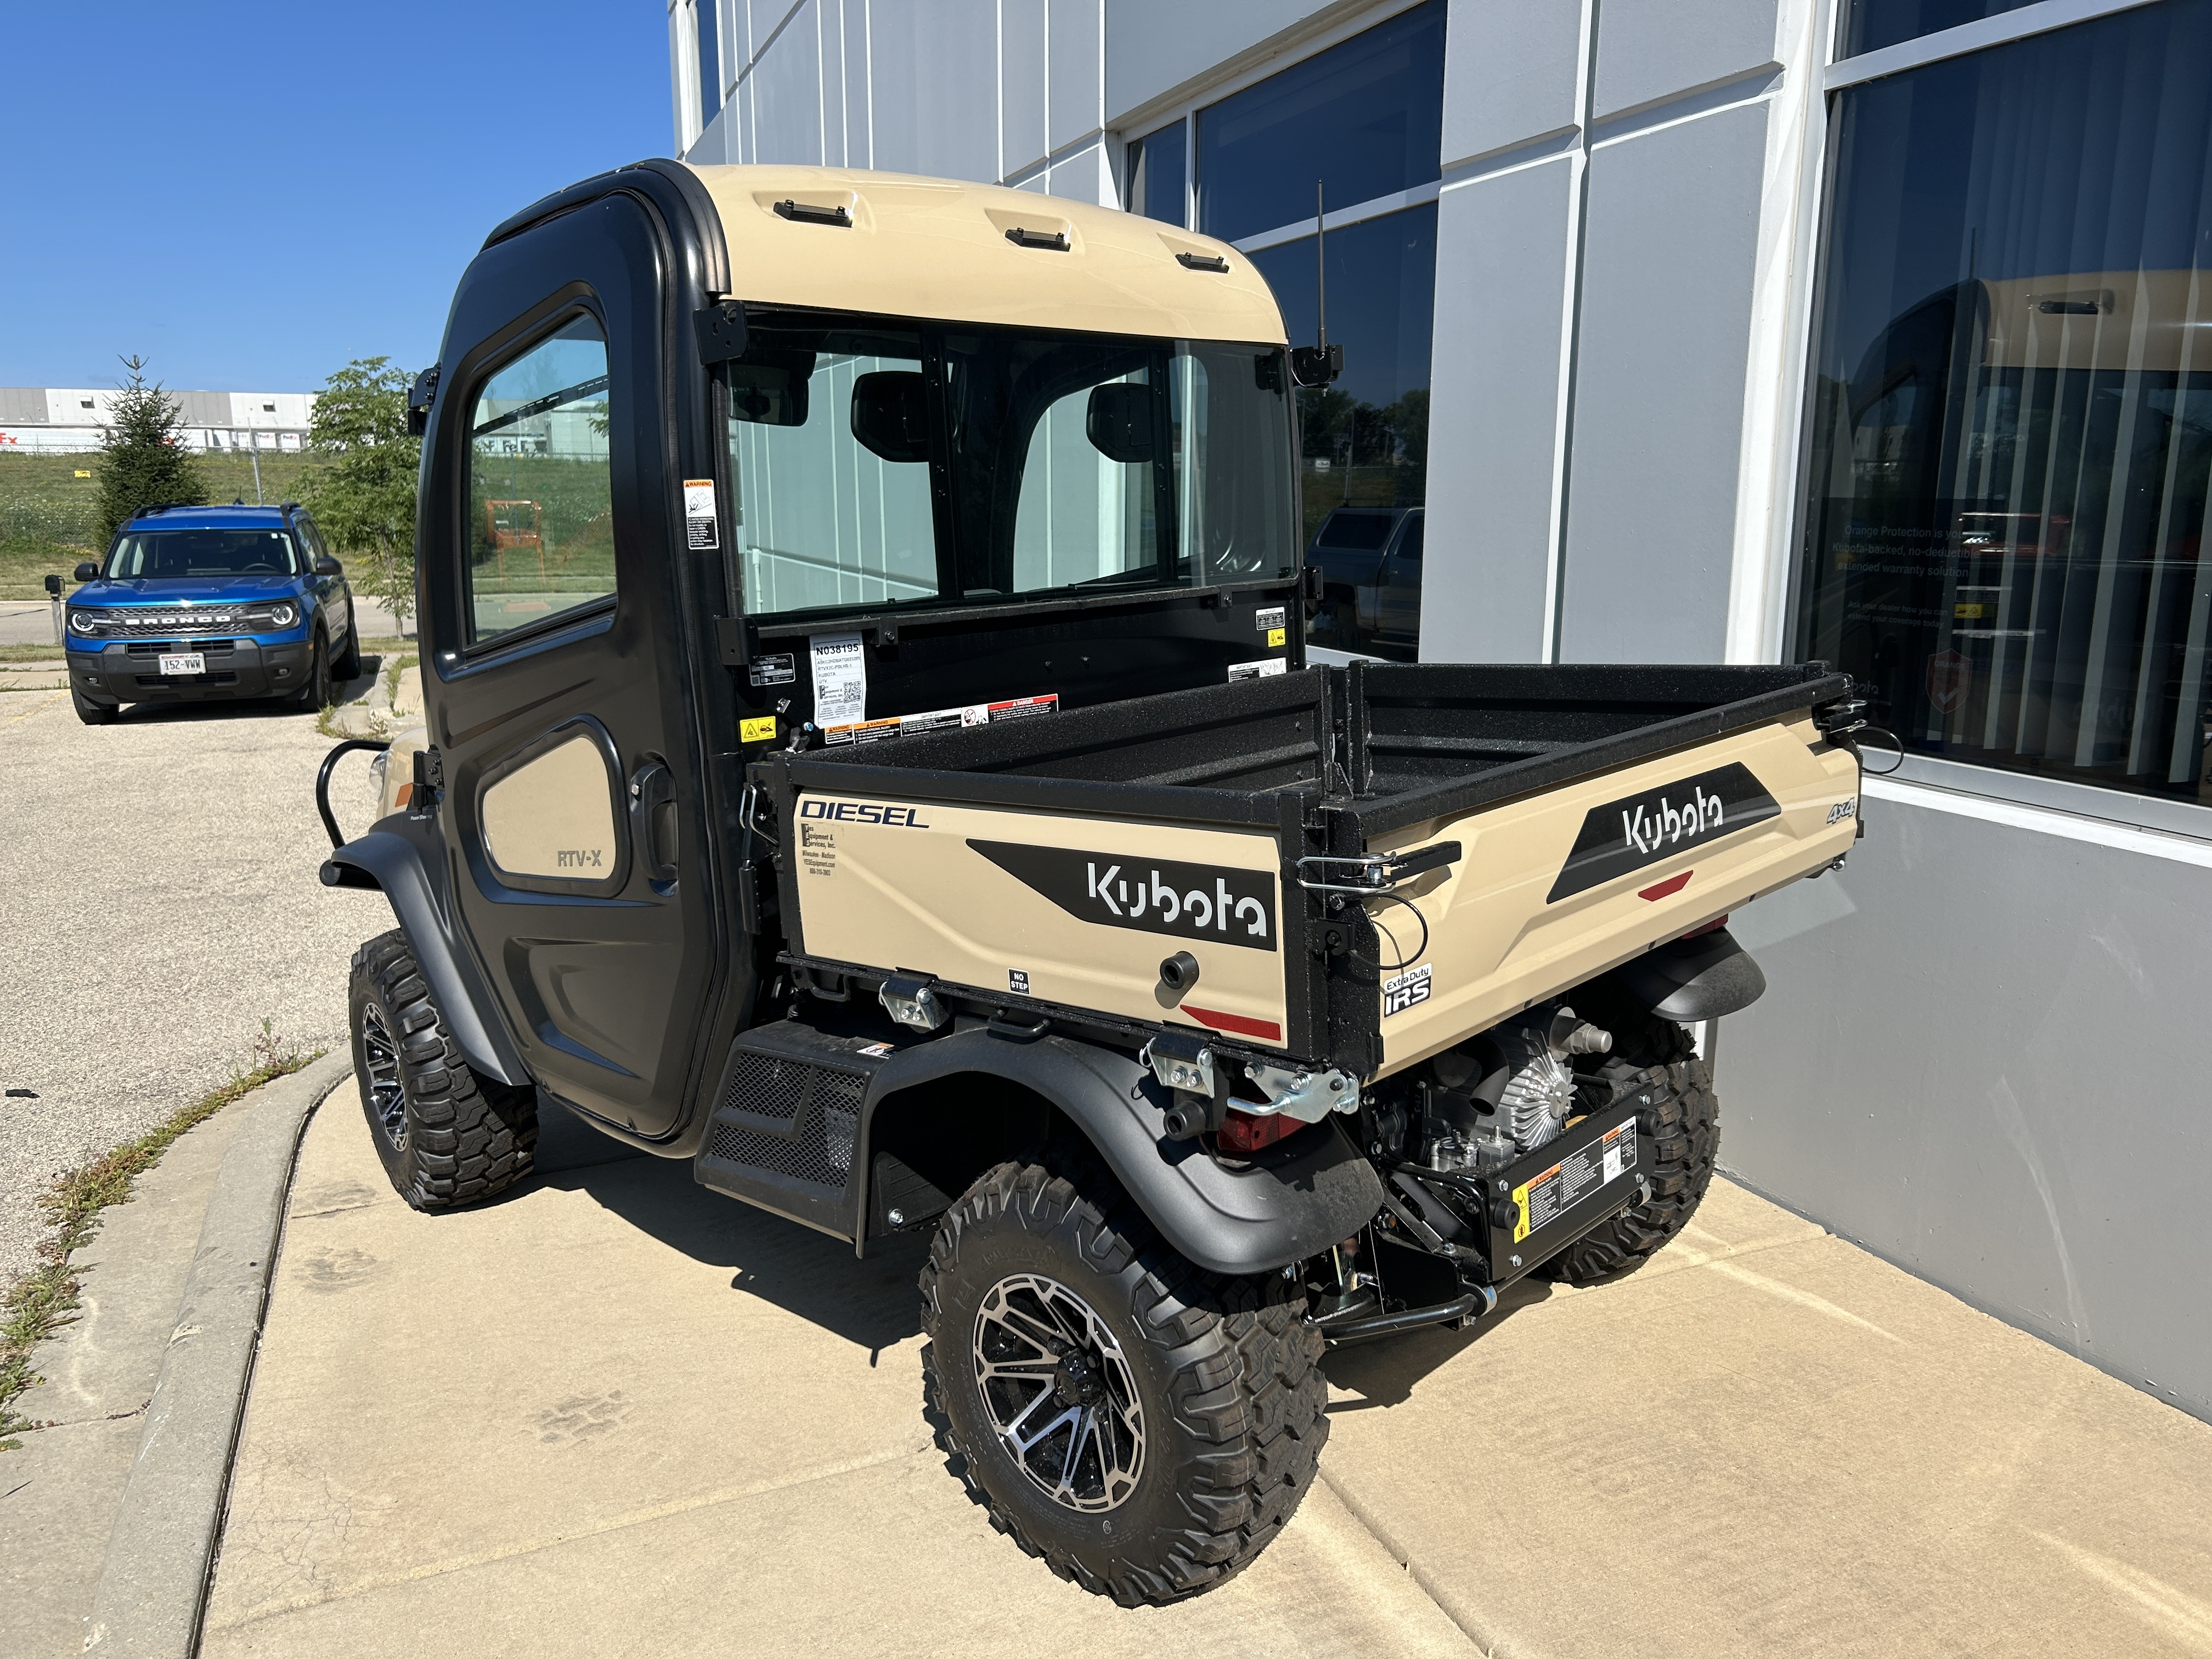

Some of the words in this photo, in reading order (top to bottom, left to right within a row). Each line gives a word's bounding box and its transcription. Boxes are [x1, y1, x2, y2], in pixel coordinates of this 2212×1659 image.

[1844, 526, 1878, 538] Orange
[1881, 526, 1931, 538] Protection
[1934, 529, 1943, 538] is
[1837, 562, 1880, 572] extended
[1882, 564, 1925, 577] warranty
[1928, 566, 1969, 578] solution
[816, 644, 859, 655] N038195
[800, 800, 930, 828] DIESEL
[1622, 786, 1723, 854] Kubota
[1826, 797, 1855, 825] 4x4
[557, 850, 602, 867] RTV-X
[1087, 862, 1267, 937] Kubota
[1011, 980, 1028, 990] STEP
[1014, 972, 1024, 981] NO
[1387, 977, 1409, 990] Extra
[1409, 968, 1429, 981] Duty
[1385, 979, 1430, 1015] IRS
